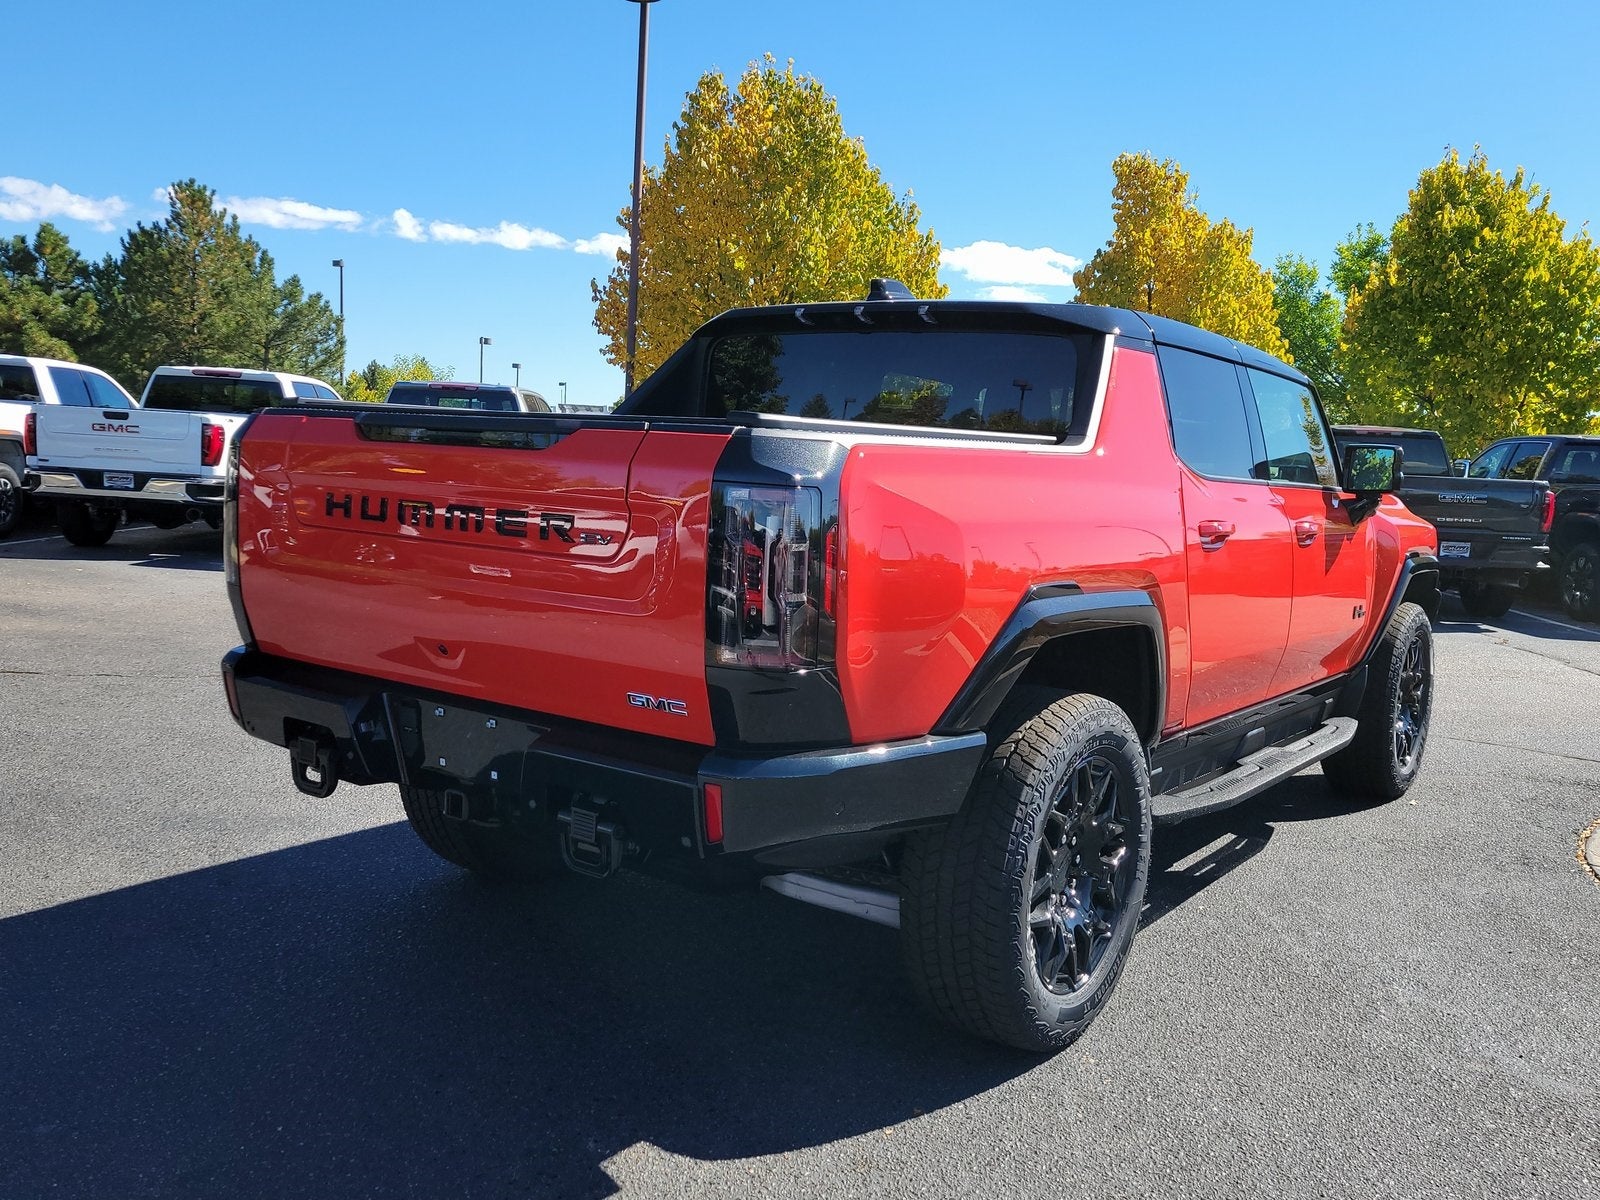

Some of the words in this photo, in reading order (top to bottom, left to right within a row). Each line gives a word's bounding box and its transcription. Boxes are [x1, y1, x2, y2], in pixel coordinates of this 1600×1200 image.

[91, 422, 140, 434] GMC
[1439, 493, 1488, 504] GMC
[325, 491, 576, 544] HUMMER
[626, 691, 689, 717] GMC
